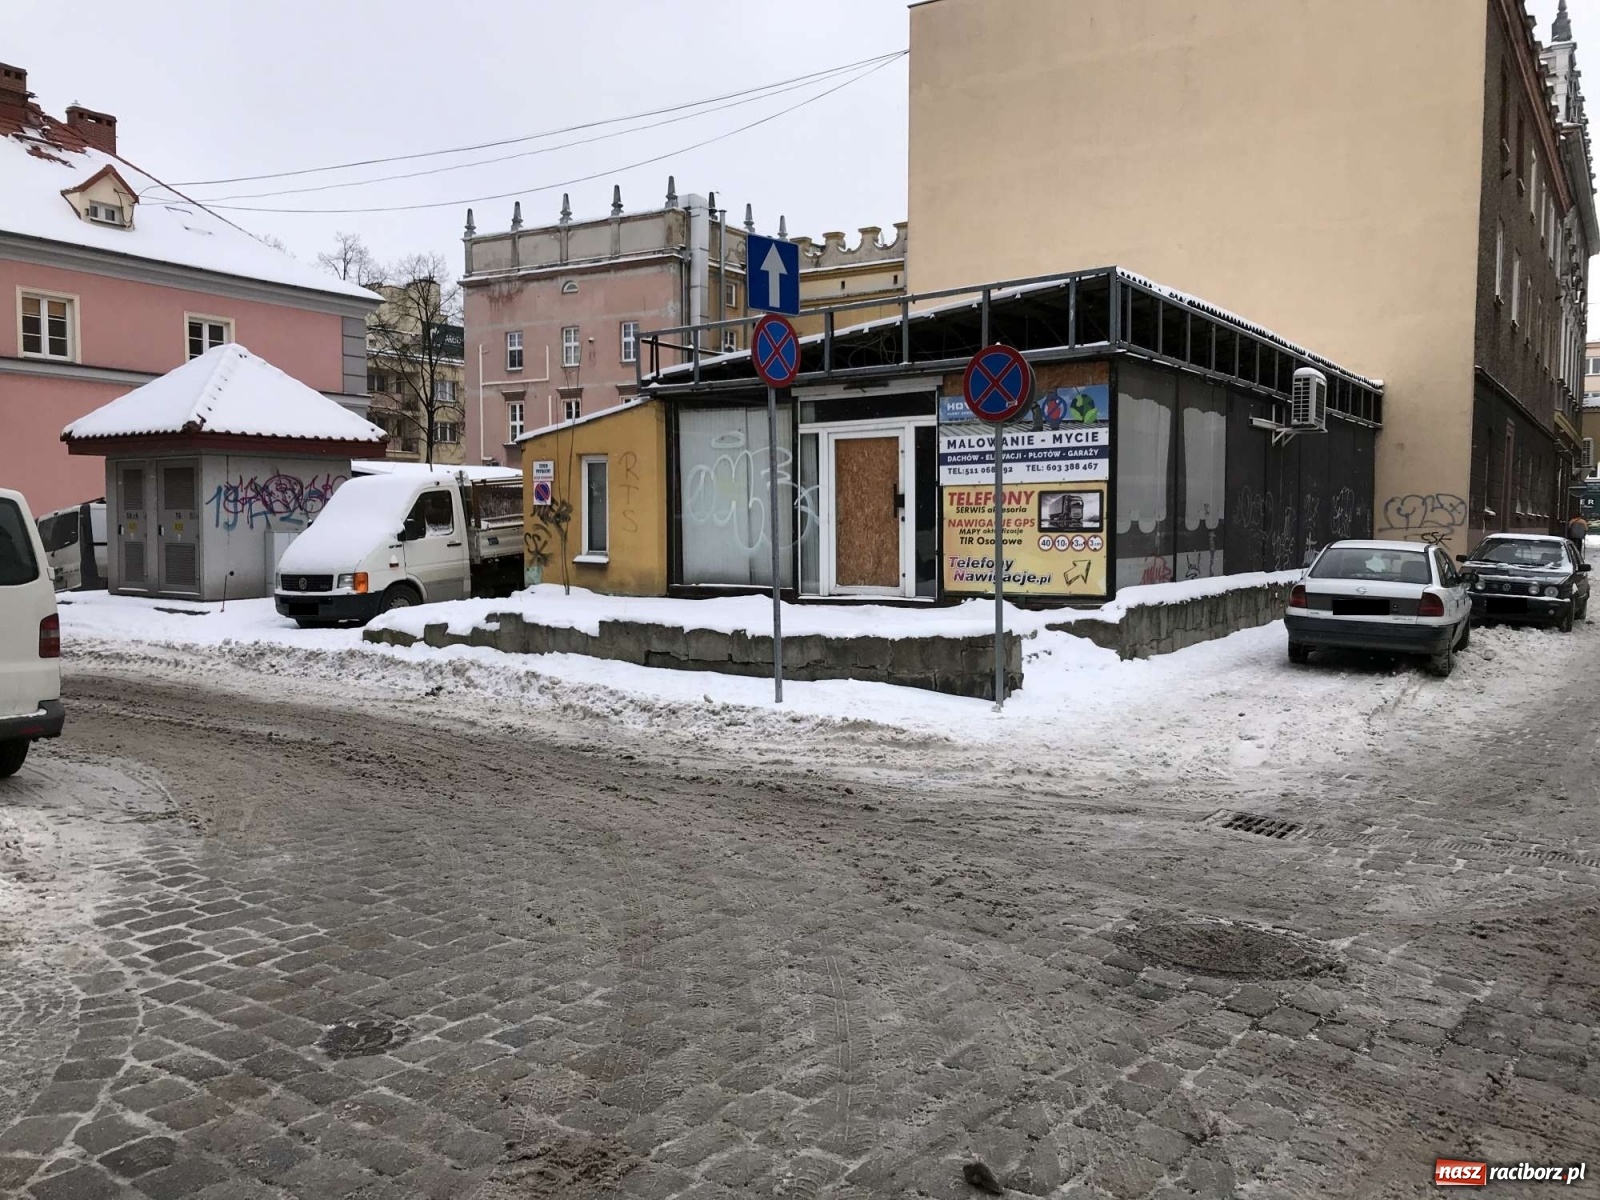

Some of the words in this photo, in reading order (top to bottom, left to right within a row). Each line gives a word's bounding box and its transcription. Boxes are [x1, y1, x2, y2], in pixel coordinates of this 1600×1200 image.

[1052, 432, 1099, 444] MYCIE
[947, 453, 980, 462] DACHÓW
[986, 452, 1022, 461] ELWACJI
[1028, 450, 1061, 459] PŁOTÓW
[1068, 448, 1099, 457] GARAŻY
[1046, 464, 1062, 472] 603
[1064, 462, 1080, 471] 388
[1082, 462, 1098, 470] 467
[948, 518, 1012, 528] NAWIGAJE
[1014, 518, 1036, 528] GPS
[960, 536, 974, 544] TIR
[977, 536, 1023, 545] Osoowe
[950, 556, 1013, 571] Telefoy
[954, 570, 1052, 585] Nawiacje.pl
